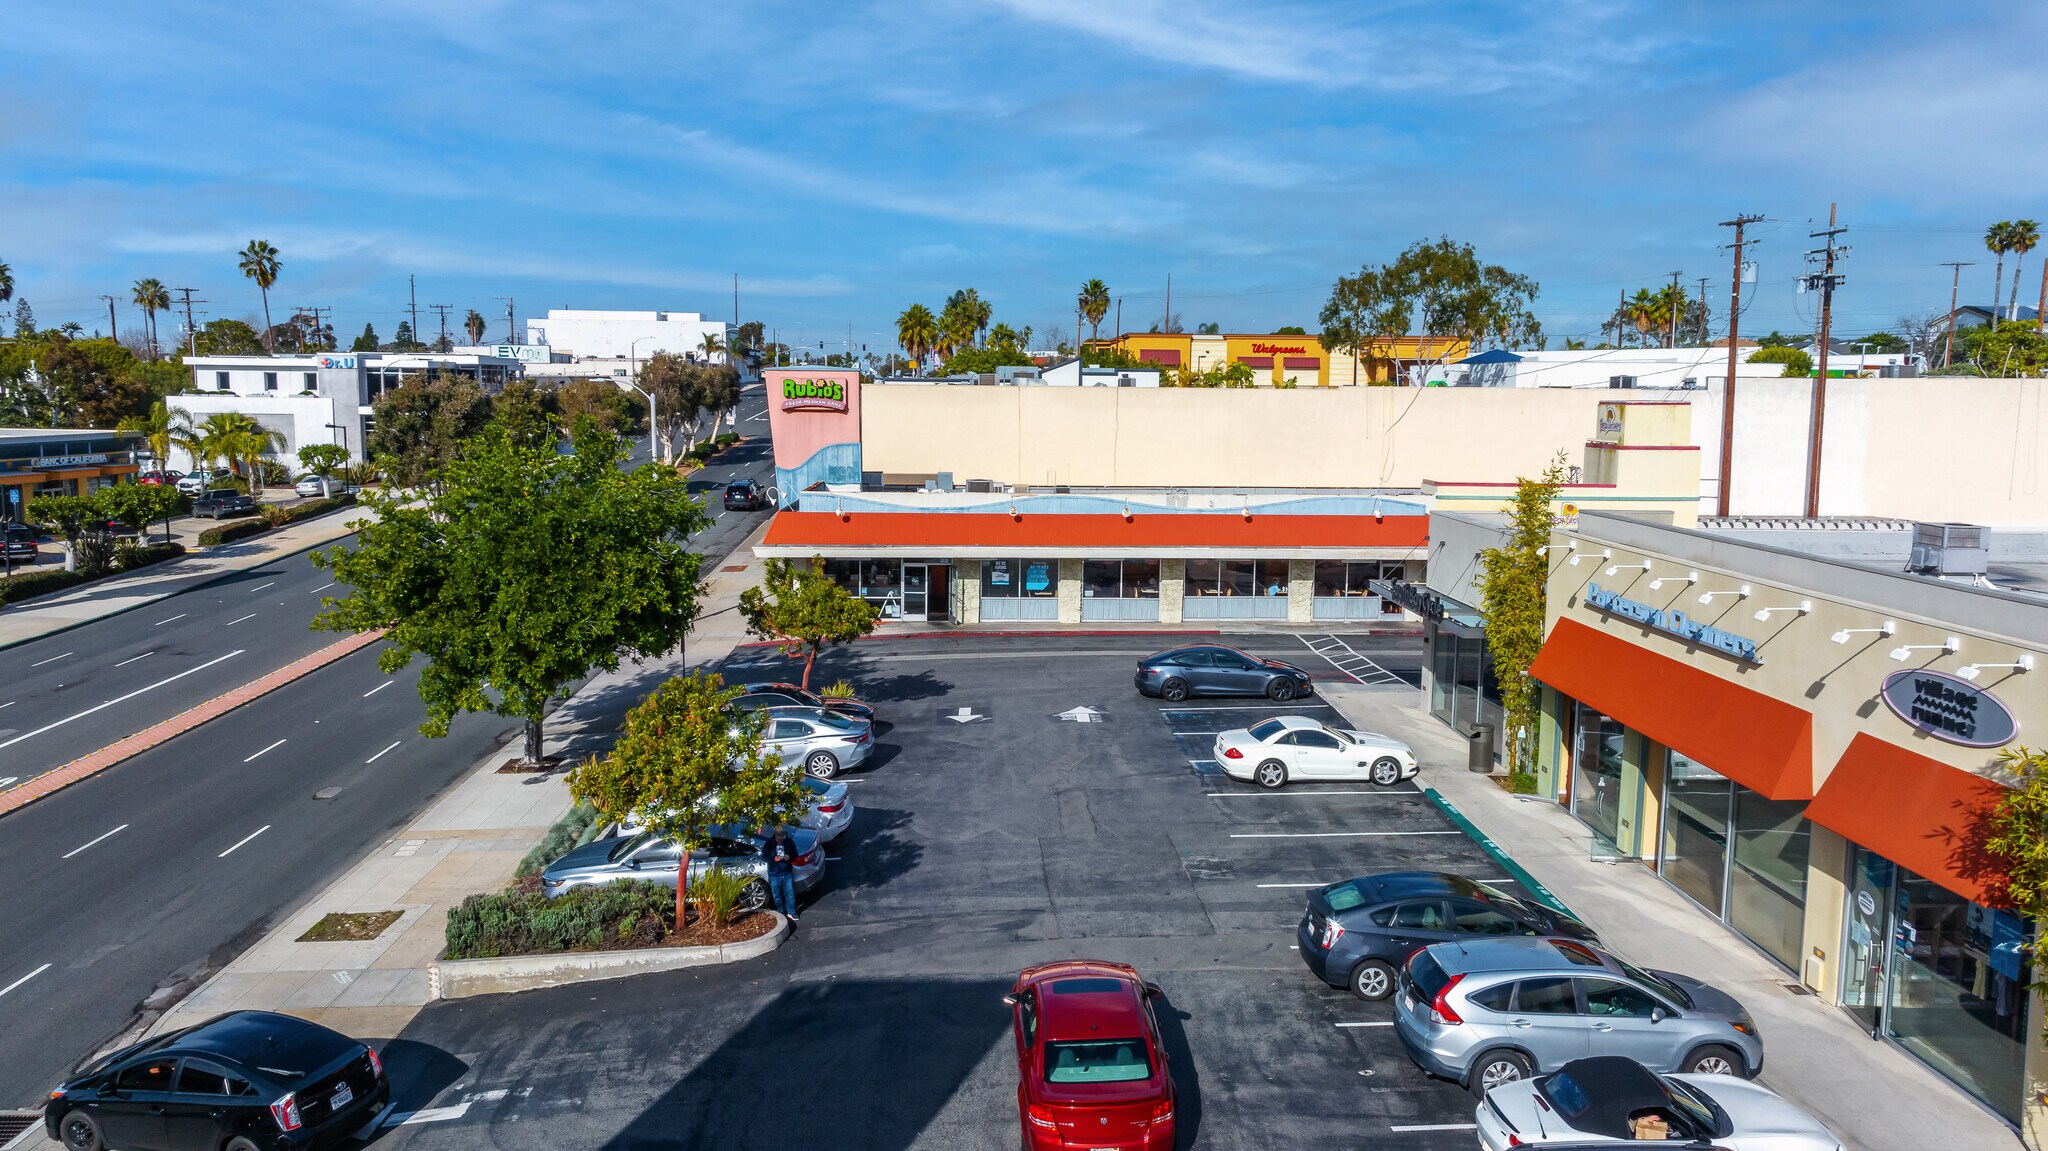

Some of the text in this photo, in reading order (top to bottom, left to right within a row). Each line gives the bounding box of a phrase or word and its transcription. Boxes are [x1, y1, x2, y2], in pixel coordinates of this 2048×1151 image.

[1252, 343, 1306, 357] Walgreens
[782, 378, 843, 401] Rubio's
[40, 454, 108, 466] BANC OF CALIFORNIA
[1588, 582, 1757, 660] Patterson Cleaners
[1914, 679, 1978, 711] village
[1911, 705, 1977, 739] runner
